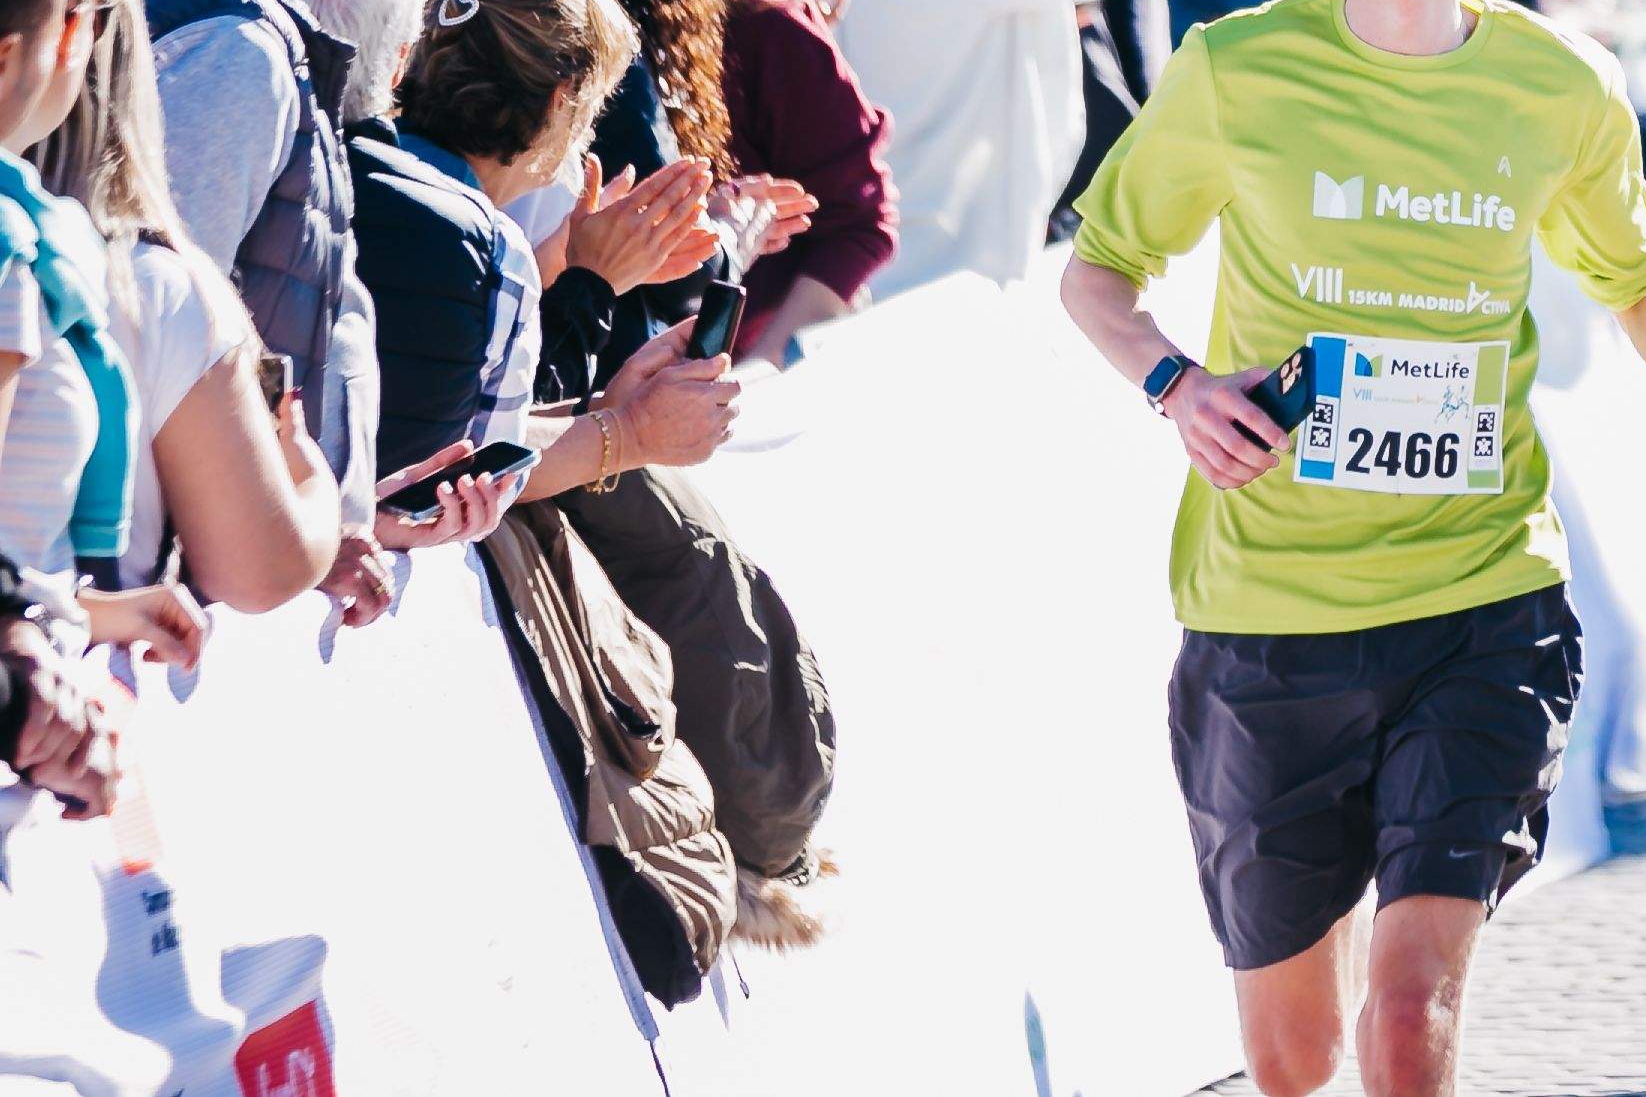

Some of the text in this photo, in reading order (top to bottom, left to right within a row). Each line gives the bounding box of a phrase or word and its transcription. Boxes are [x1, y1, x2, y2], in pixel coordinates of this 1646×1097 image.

[1375, 184, 1516, 231] MetLife
[1290, 261, 1344, 304] VIII
[1348, 289, 1392, 307] 15KM
[1398, 292, 1466, 313] MADRID
[1390, 359, 1470, 379] MetLife
[1352, 388, 1373, 402] VIII
[1345, 427, 1460, 479] 2466
